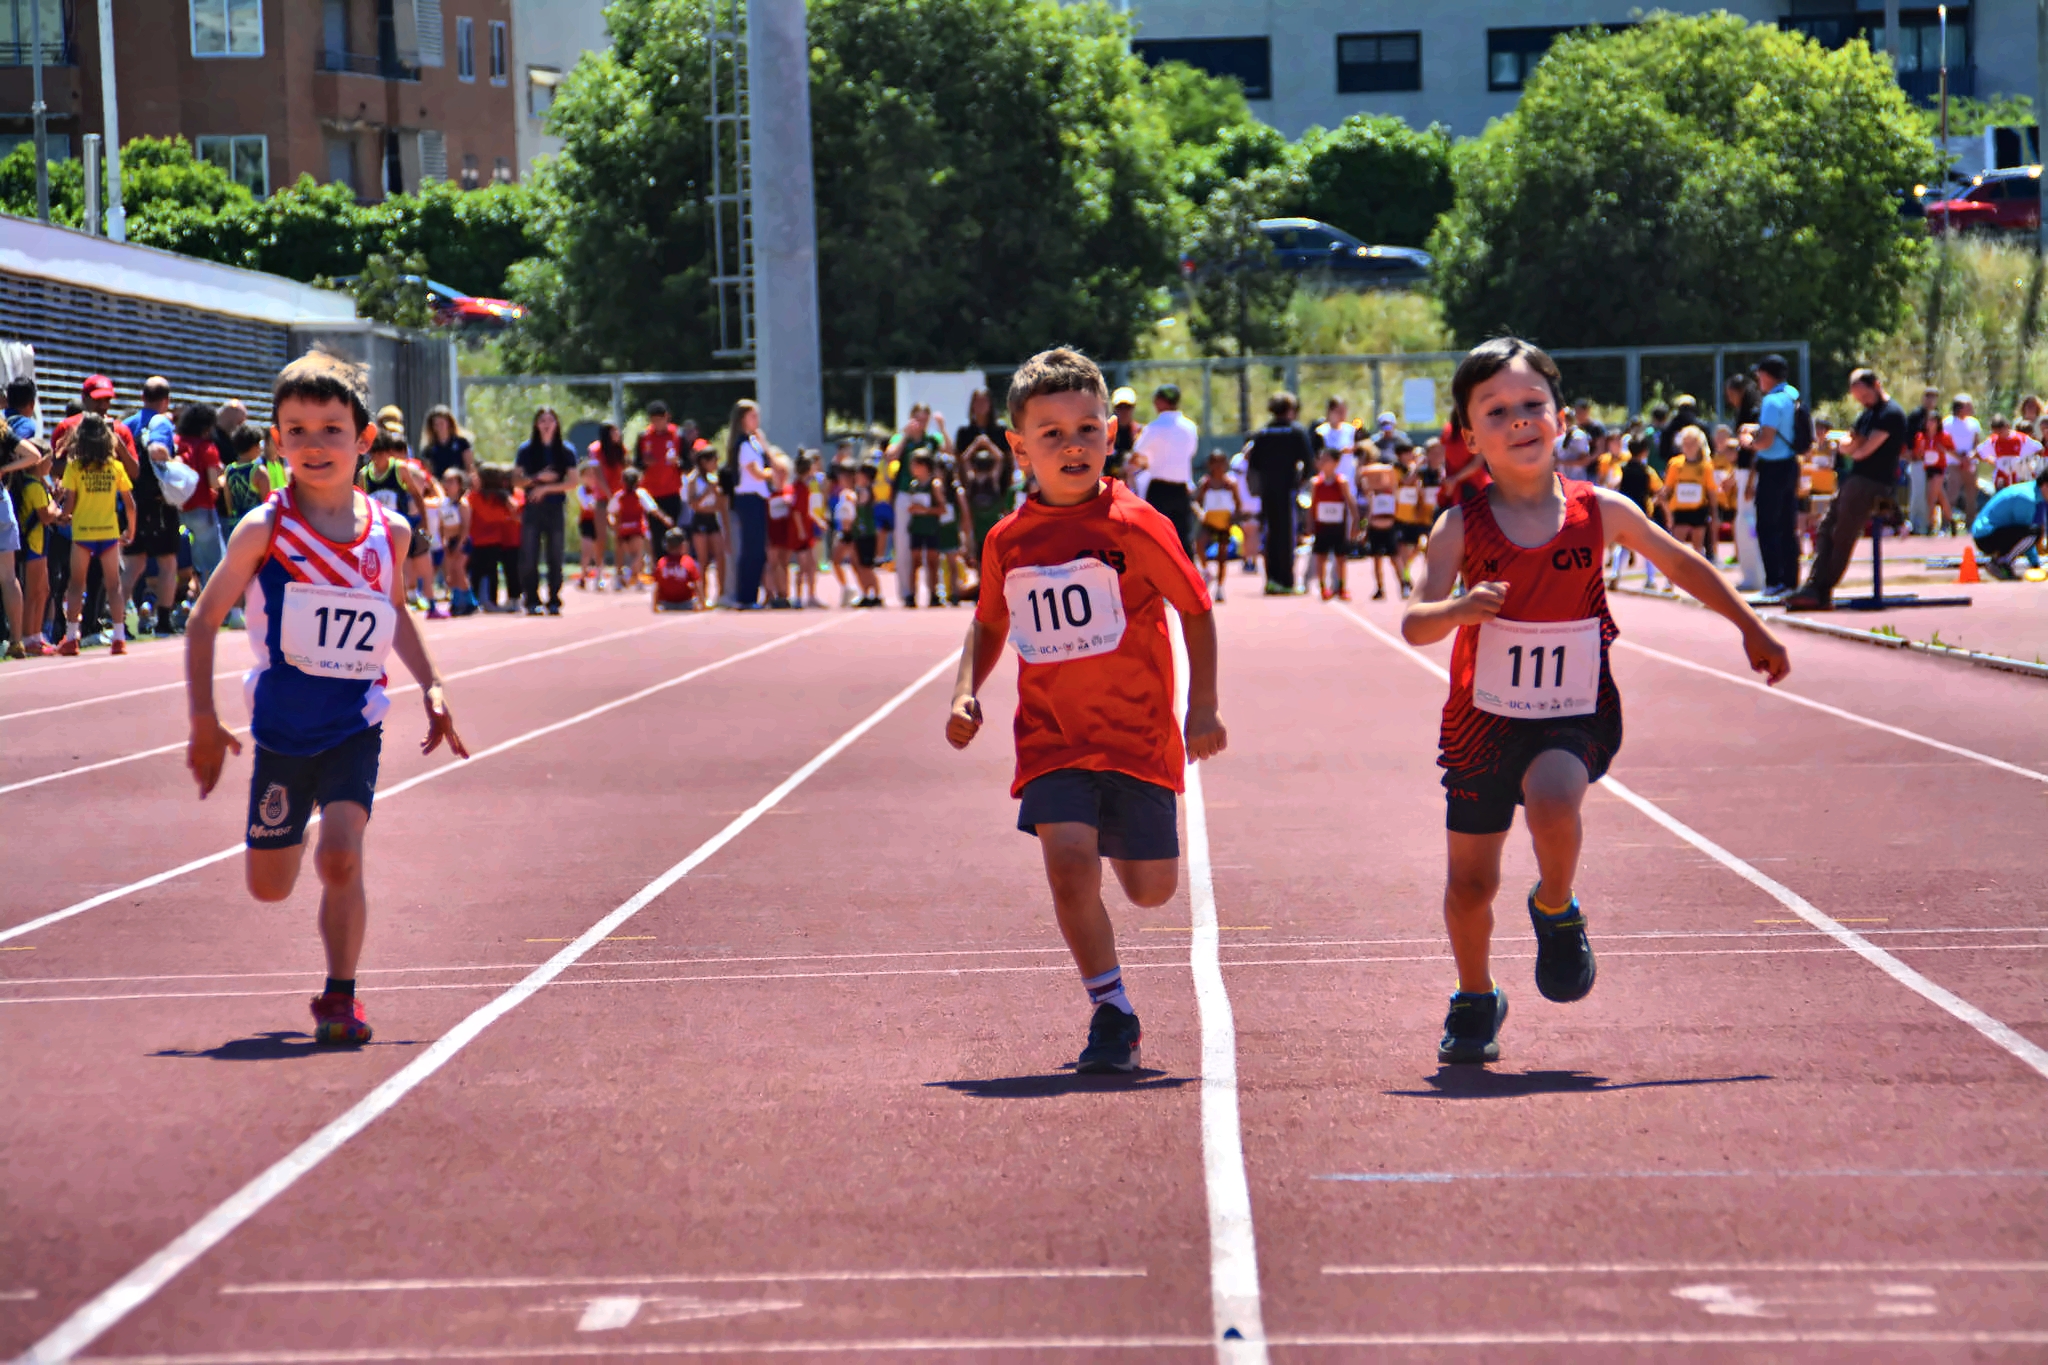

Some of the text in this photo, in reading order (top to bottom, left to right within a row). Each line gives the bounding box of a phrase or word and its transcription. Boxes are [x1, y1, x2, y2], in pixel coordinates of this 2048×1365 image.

[314, 607, 376, 651] 172
[1028, 584, 1092, 632] 110
[1507, 645, 1565, 688] 111
